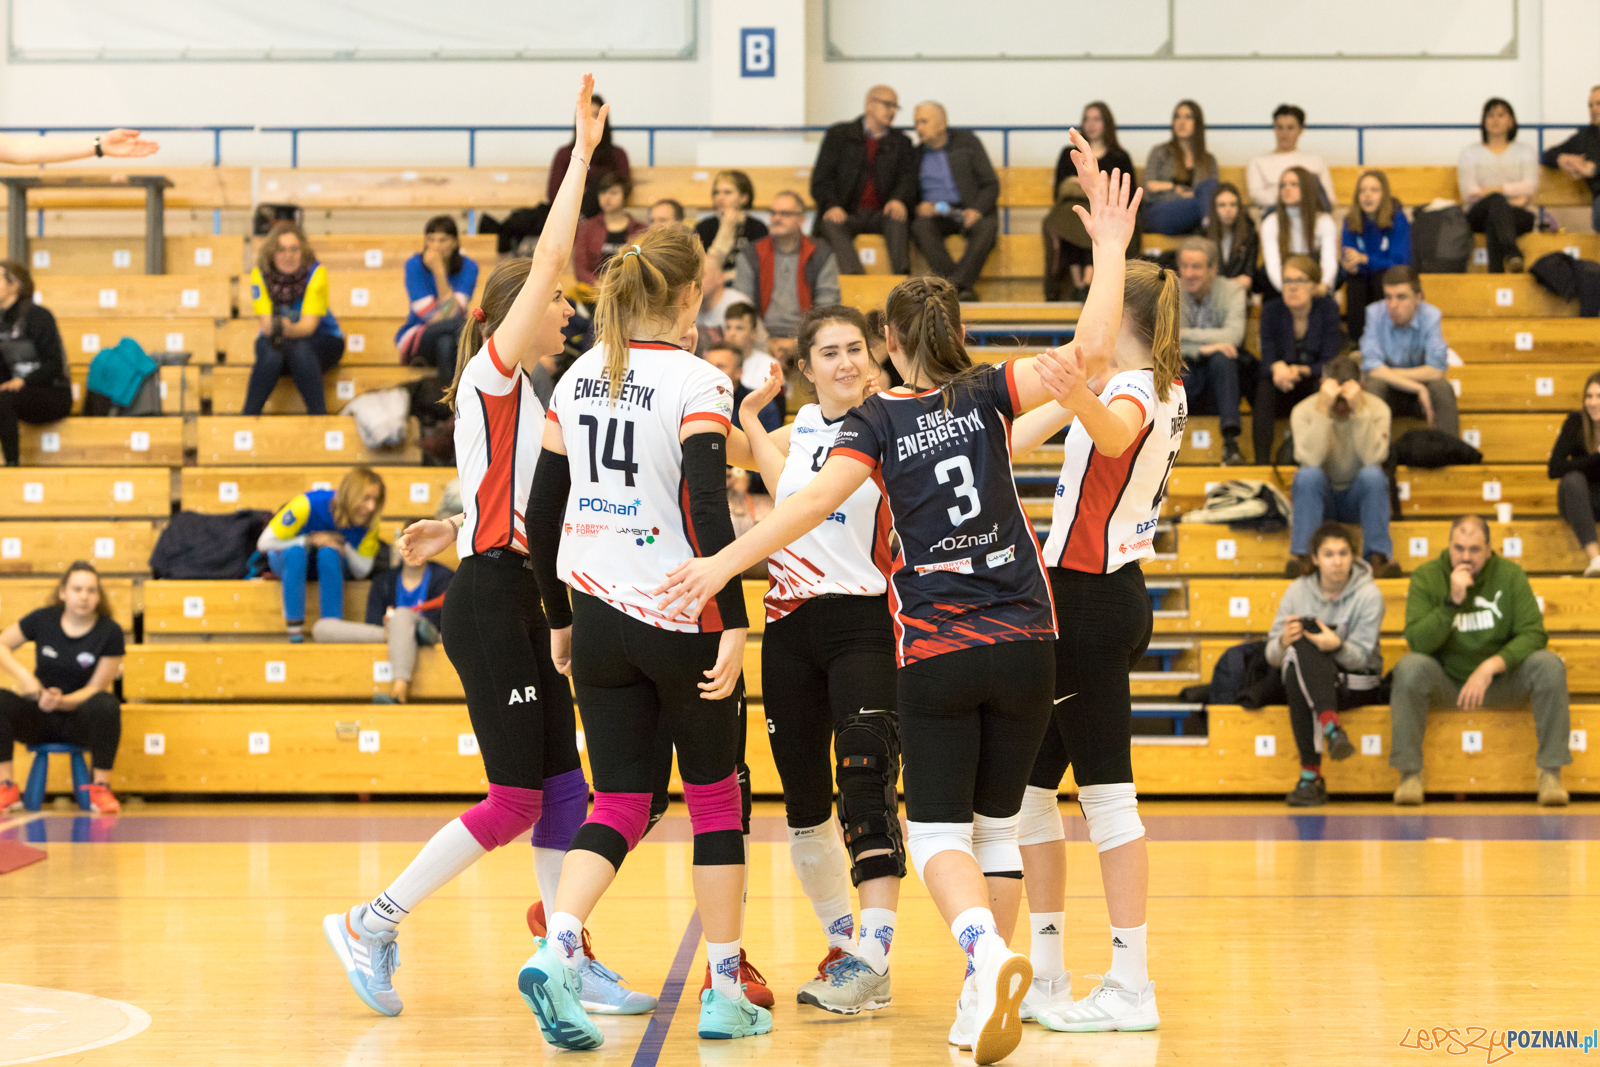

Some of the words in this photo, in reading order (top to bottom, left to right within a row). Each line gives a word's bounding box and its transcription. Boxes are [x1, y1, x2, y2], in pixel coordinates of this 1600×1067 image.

[746, 34, 770, 70] B
[896, 408, 985, 462] ENERGETYK
[916, 408, 954, 431] ENEA
[578, 414, 639, 488] 14
[934, 455, 981, 527] 3
[576, 523, 609, 531] FABRYKA
[508, 686, 538, 705] AR
